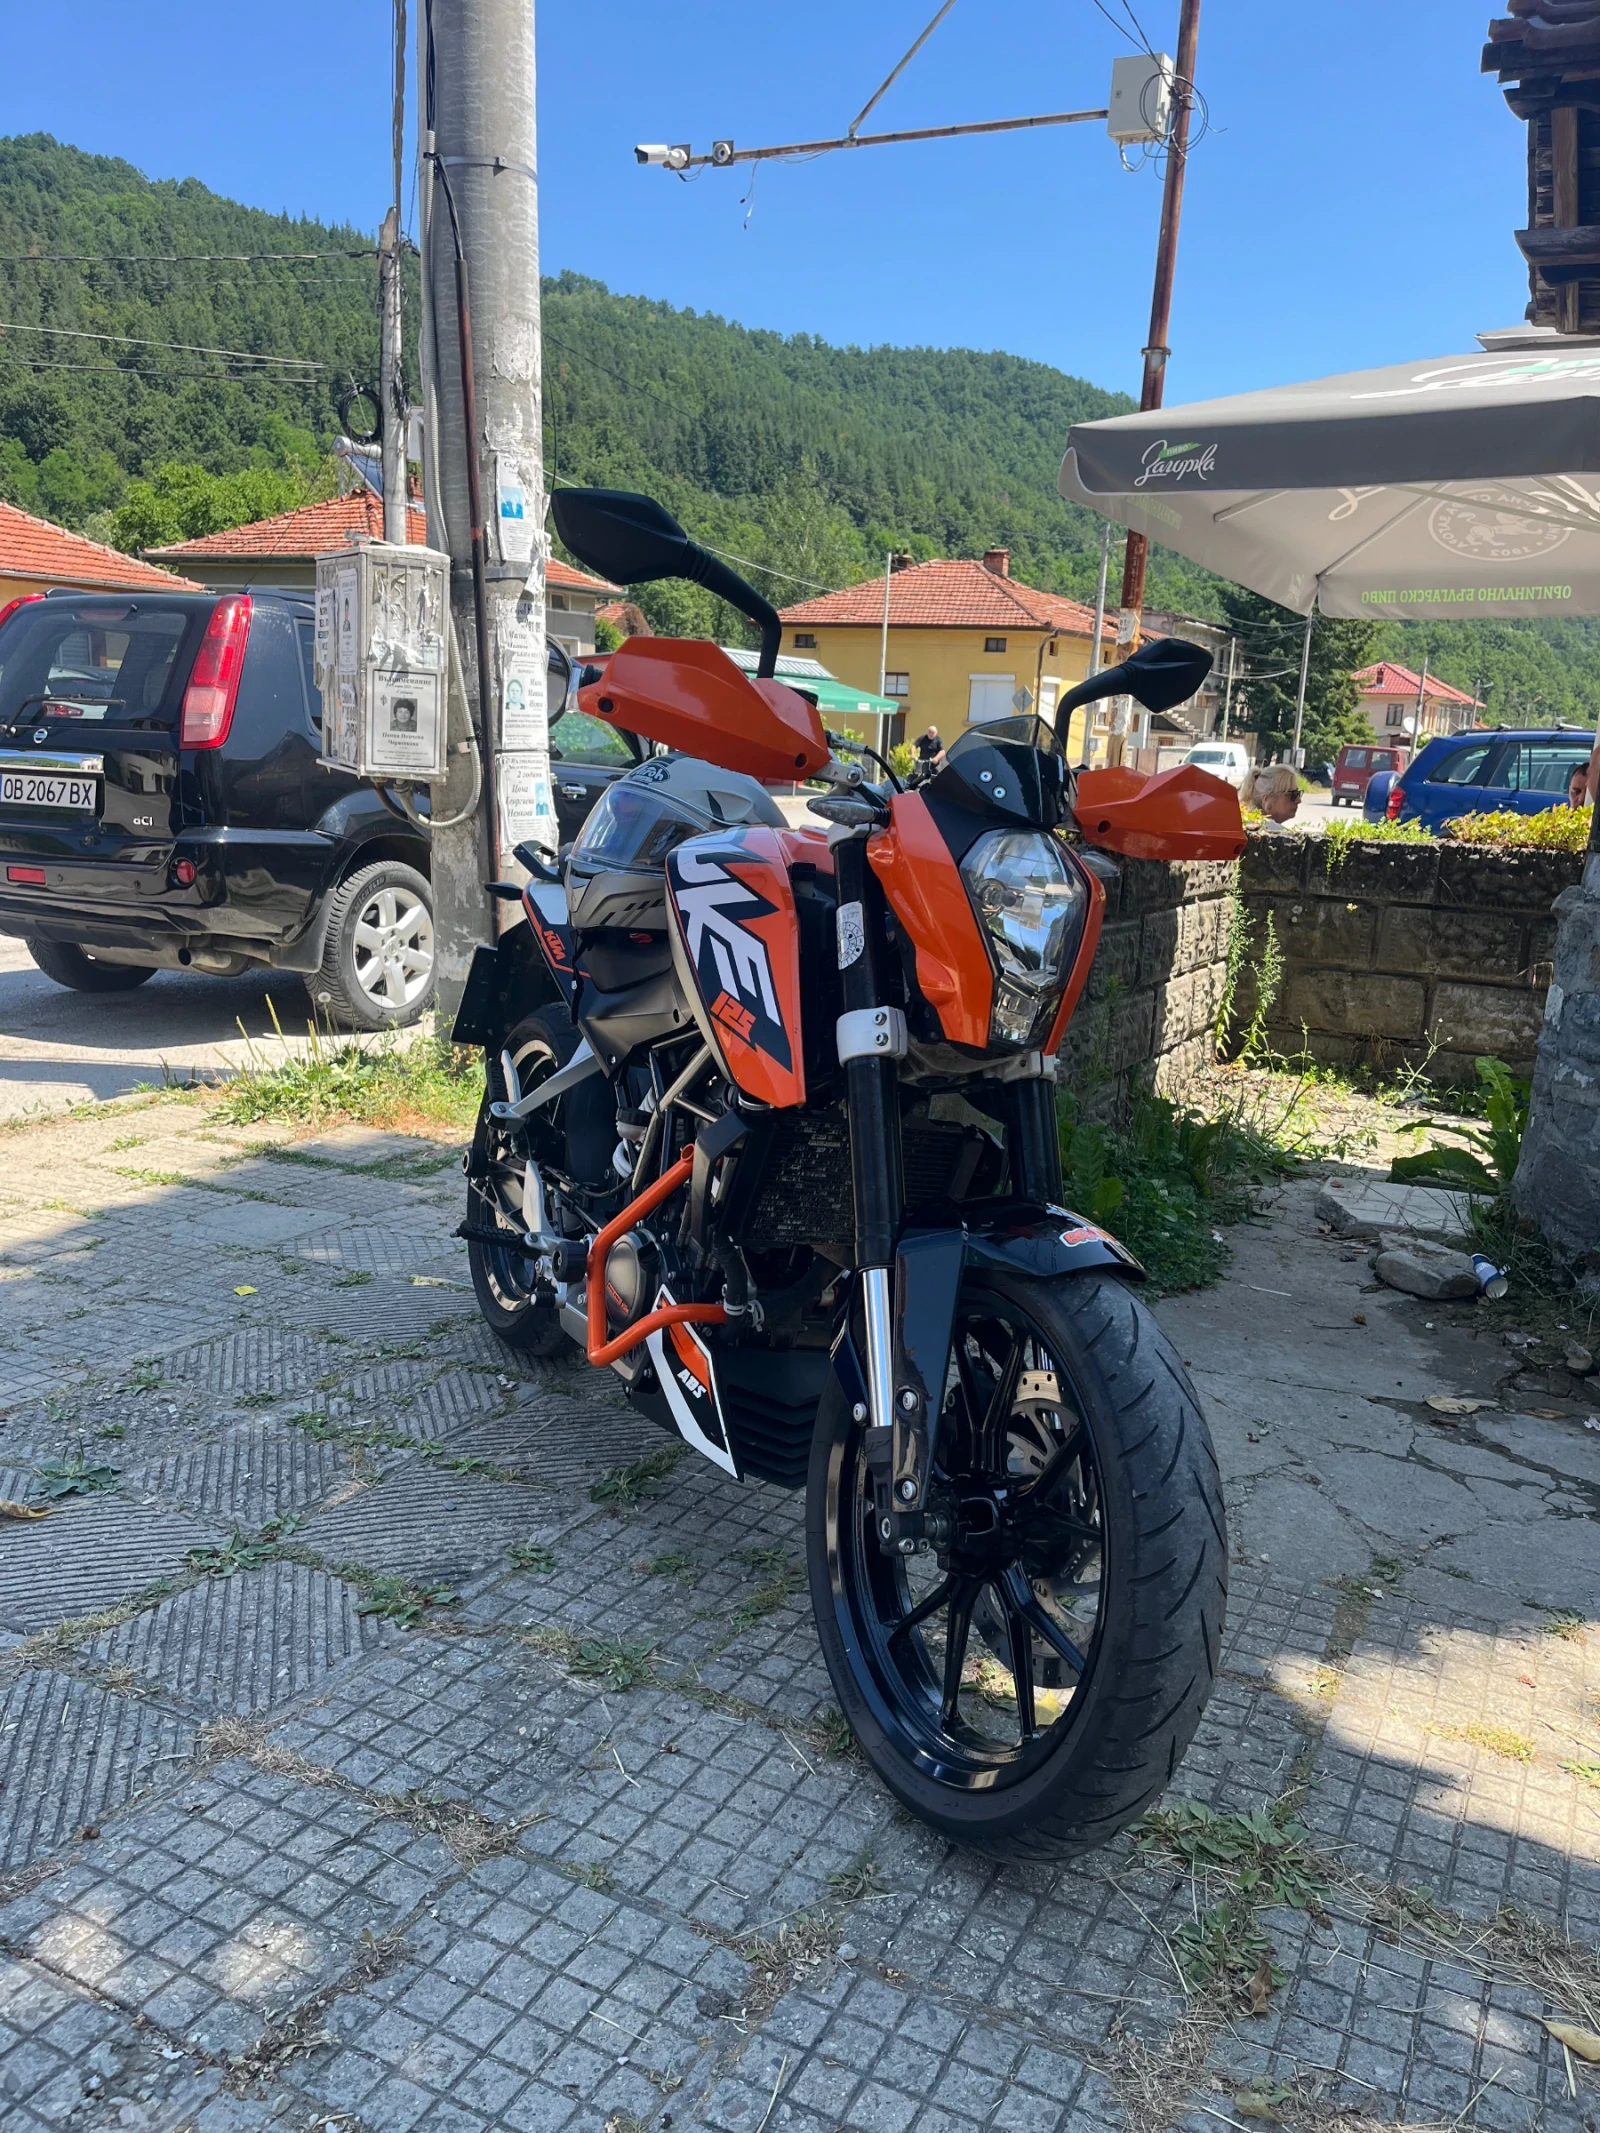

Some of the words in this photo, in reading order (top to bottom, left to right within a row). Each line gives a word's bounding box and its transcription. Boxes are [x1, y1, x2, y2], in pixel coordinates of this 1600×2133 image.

[1133, 439, 1219, 487] Загорка
[3, 778, 24, 800] OB
[26, 780, 67, 804] 2067
[69, 782, 93, 806] BX
[543, 930, 566, 960] KTM
[710, 990, 757, 1043] 125
[677, 1368, 708, 1399] ABS
